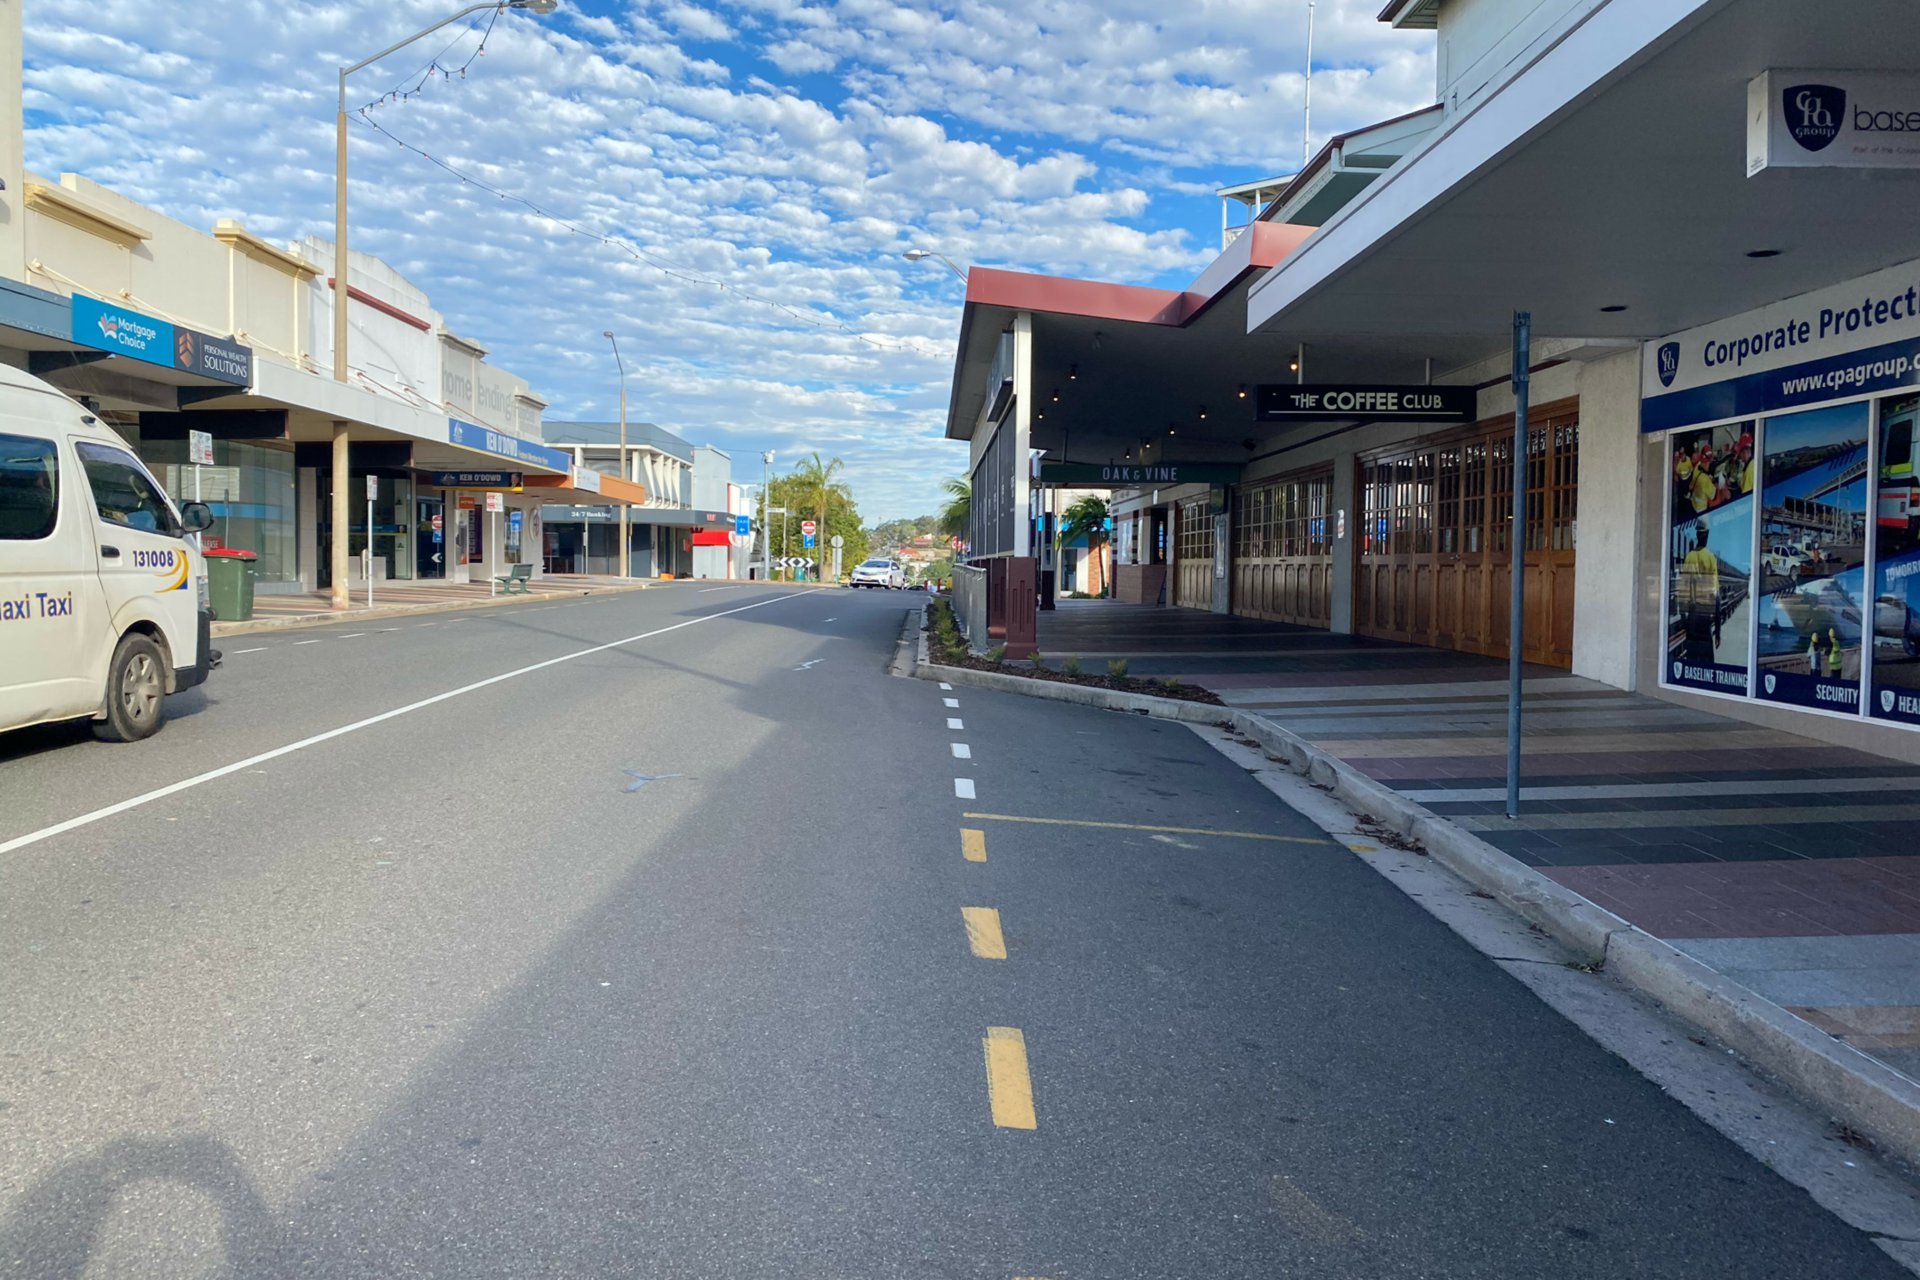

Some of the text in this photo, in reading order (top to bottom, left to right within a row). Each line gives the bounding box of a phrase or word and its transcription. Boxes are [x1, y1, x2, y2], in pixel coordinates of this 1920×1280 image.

[118, 317, 156, 340] Mortgage
[118, 332, 146, 350] Choice
[1703, 319, 1810, 367] Corporate
[204, 344, 247, 363] PERSONAL WEALTH
[204, 355, 248, 378] SOLUTIONS
[477, 376, 512, 420] lending
[1290, 391, 1442, 410] THE COFFEE CLUB
[460, 473, 473, 481] KEN
[1102, 467, 1177, 480] OAK & VINE
[133, 550, 174, 567] 131008
[0, 591, 72, 621] axi Taxi
[1684, 665, 1749, 688] BASELINE TRAINING
[1816, 684, 1859, 704] SECURITY
